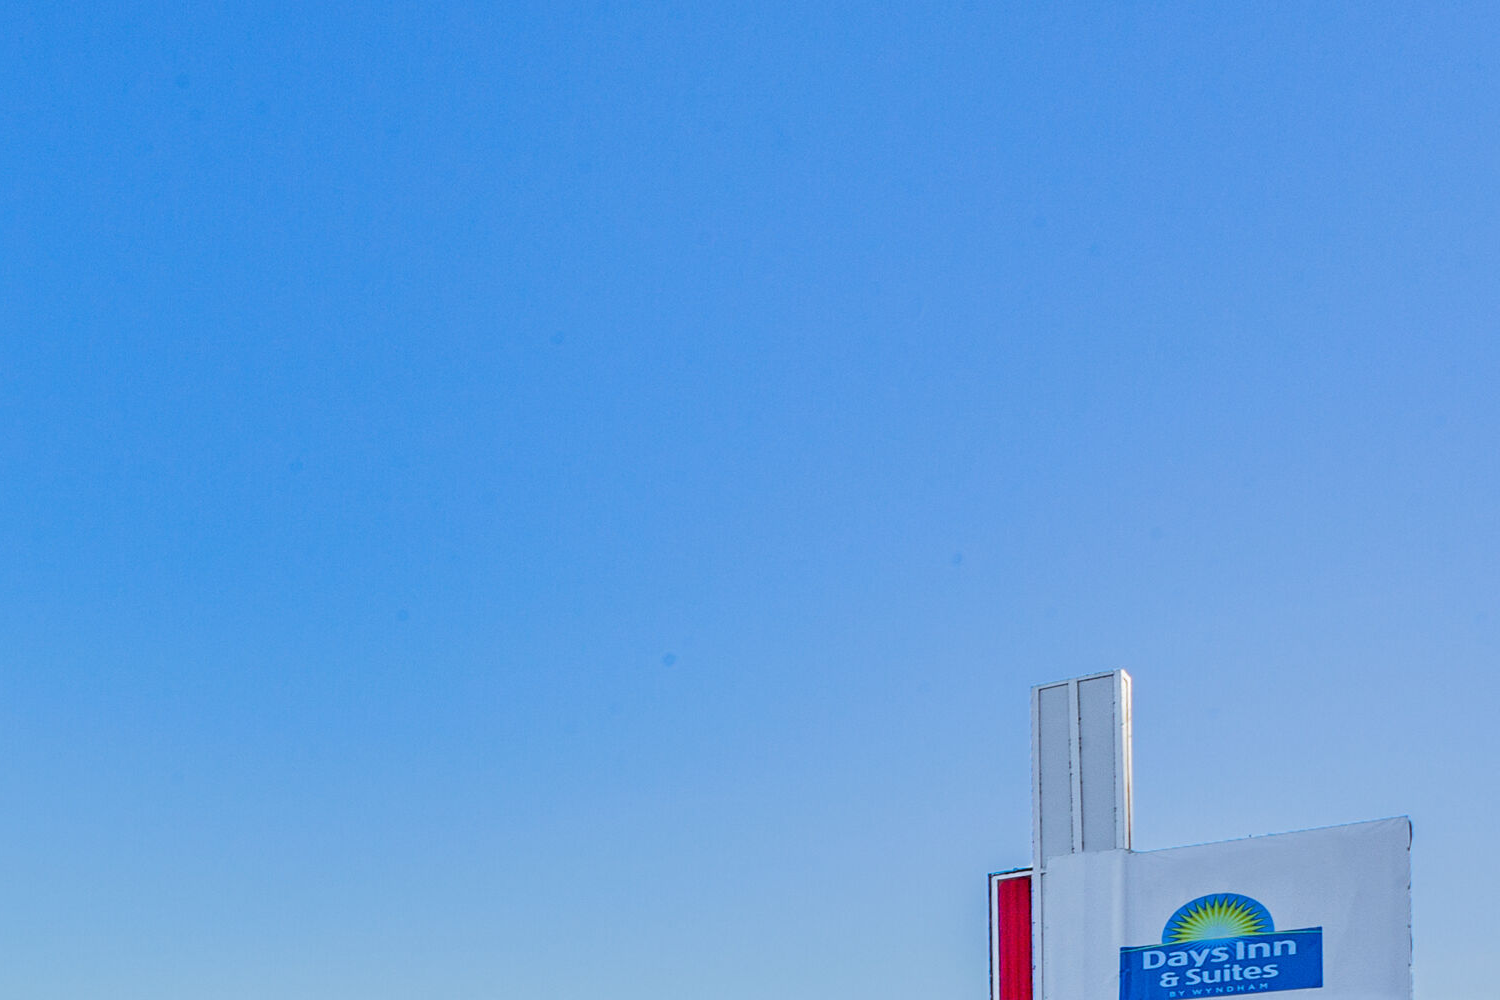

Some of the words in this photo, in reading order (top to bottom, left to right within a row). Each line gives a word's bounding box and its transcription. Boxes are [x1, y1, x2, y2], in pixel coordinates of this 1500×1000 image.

[1142, 946, 1230, 970] Days
[1235, 939, 1297, 960] Inn
[1159, 972, 1180, 988] &
[1185, 963, 1279, 986] Suites
[1169, 990, 1185, 998] BY
[1192, 982, 1269, 995] WYNDHAM
